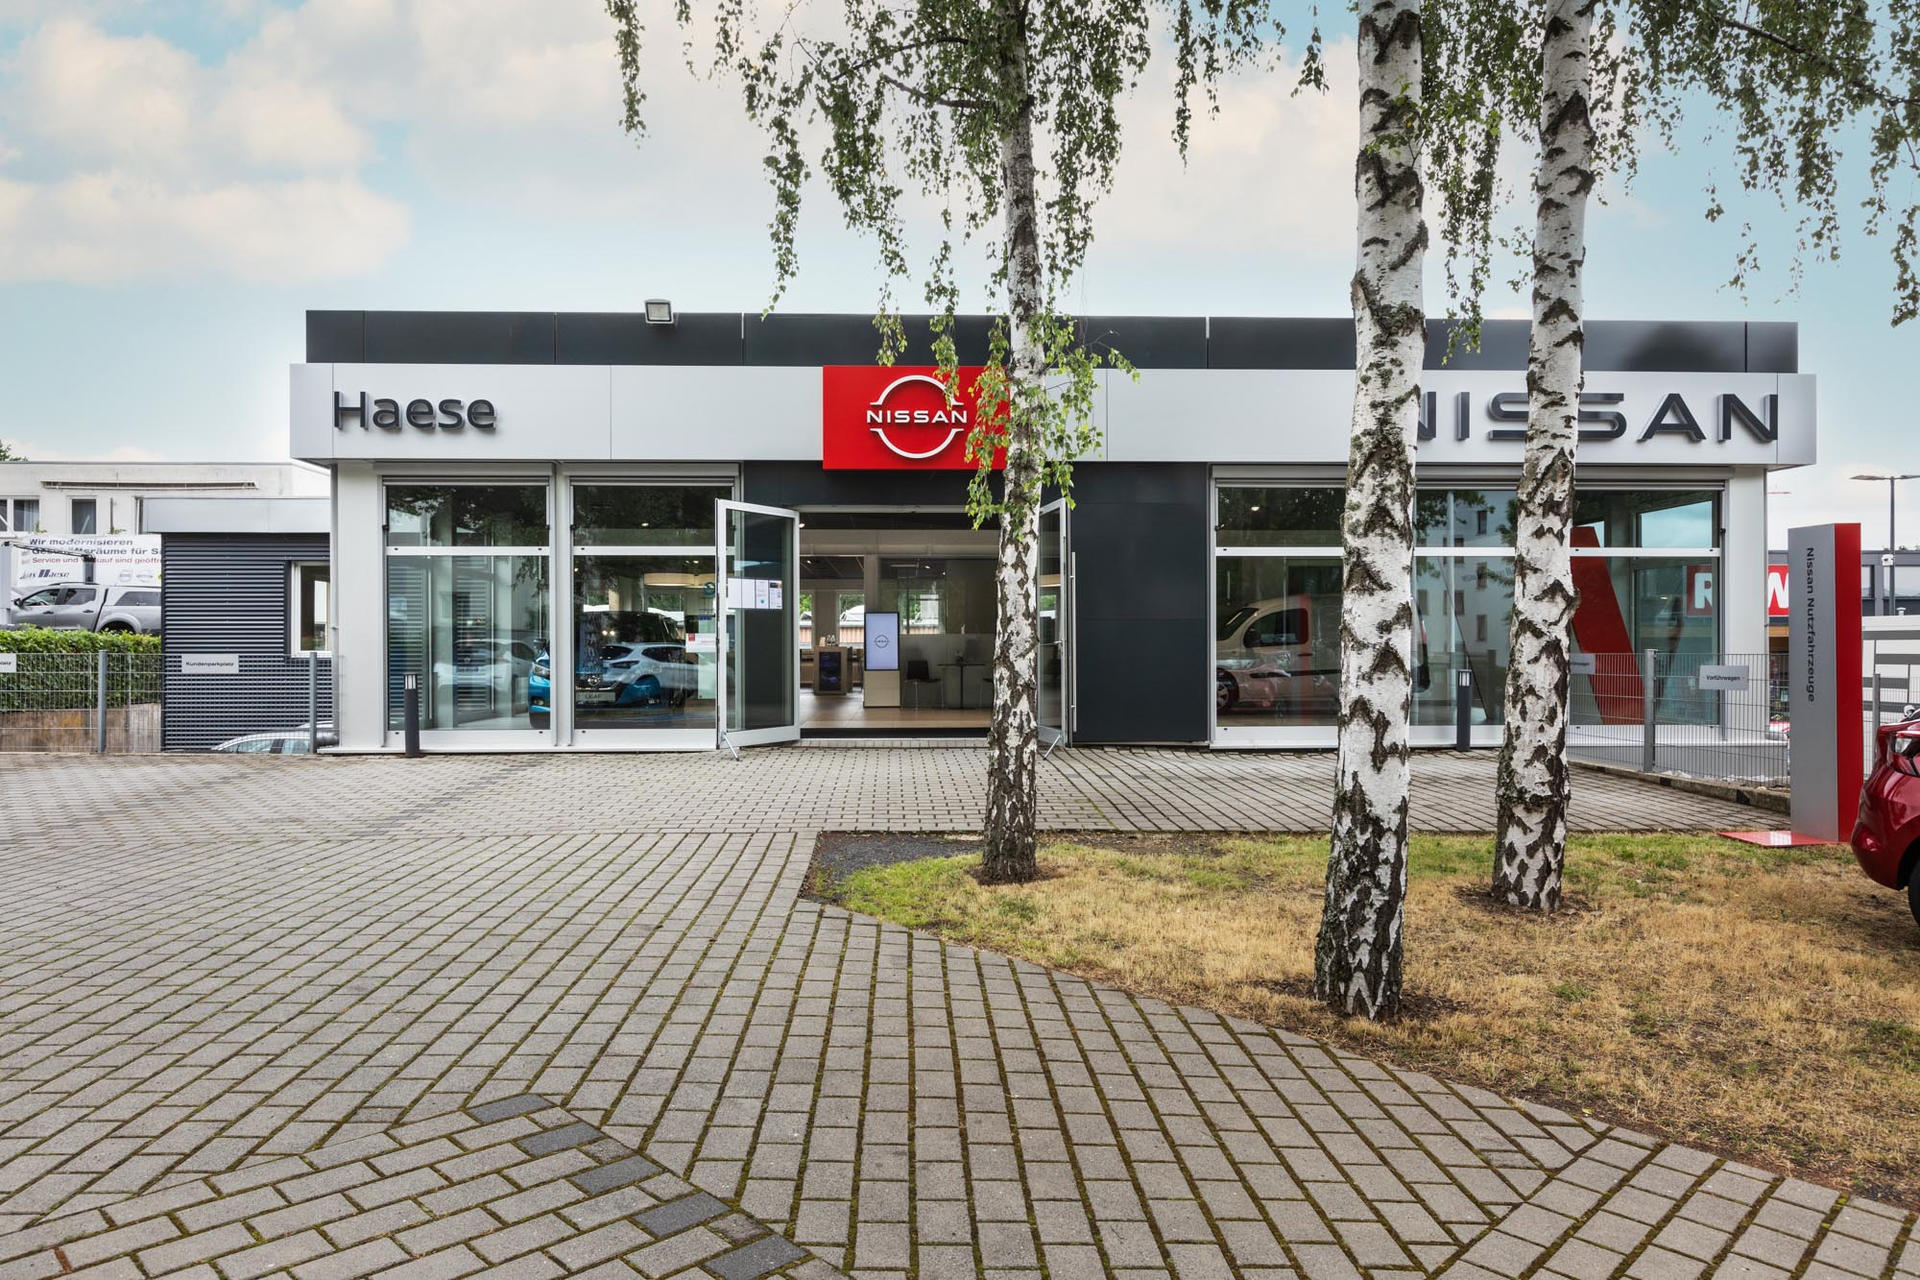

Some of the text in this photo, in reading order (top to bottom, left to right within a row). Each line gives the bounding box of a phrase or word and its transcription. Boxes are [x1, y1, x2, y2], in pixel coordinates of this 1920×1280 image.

[334, 391, 496, 429] Haese
[866, 410, 967, 423] NISSAN
[50, 538, 133, 546] modernisieren
[131, 547, 148, 555] für
[1806, 547, 1816, 702] Nissan Nutzfahrzeuge
